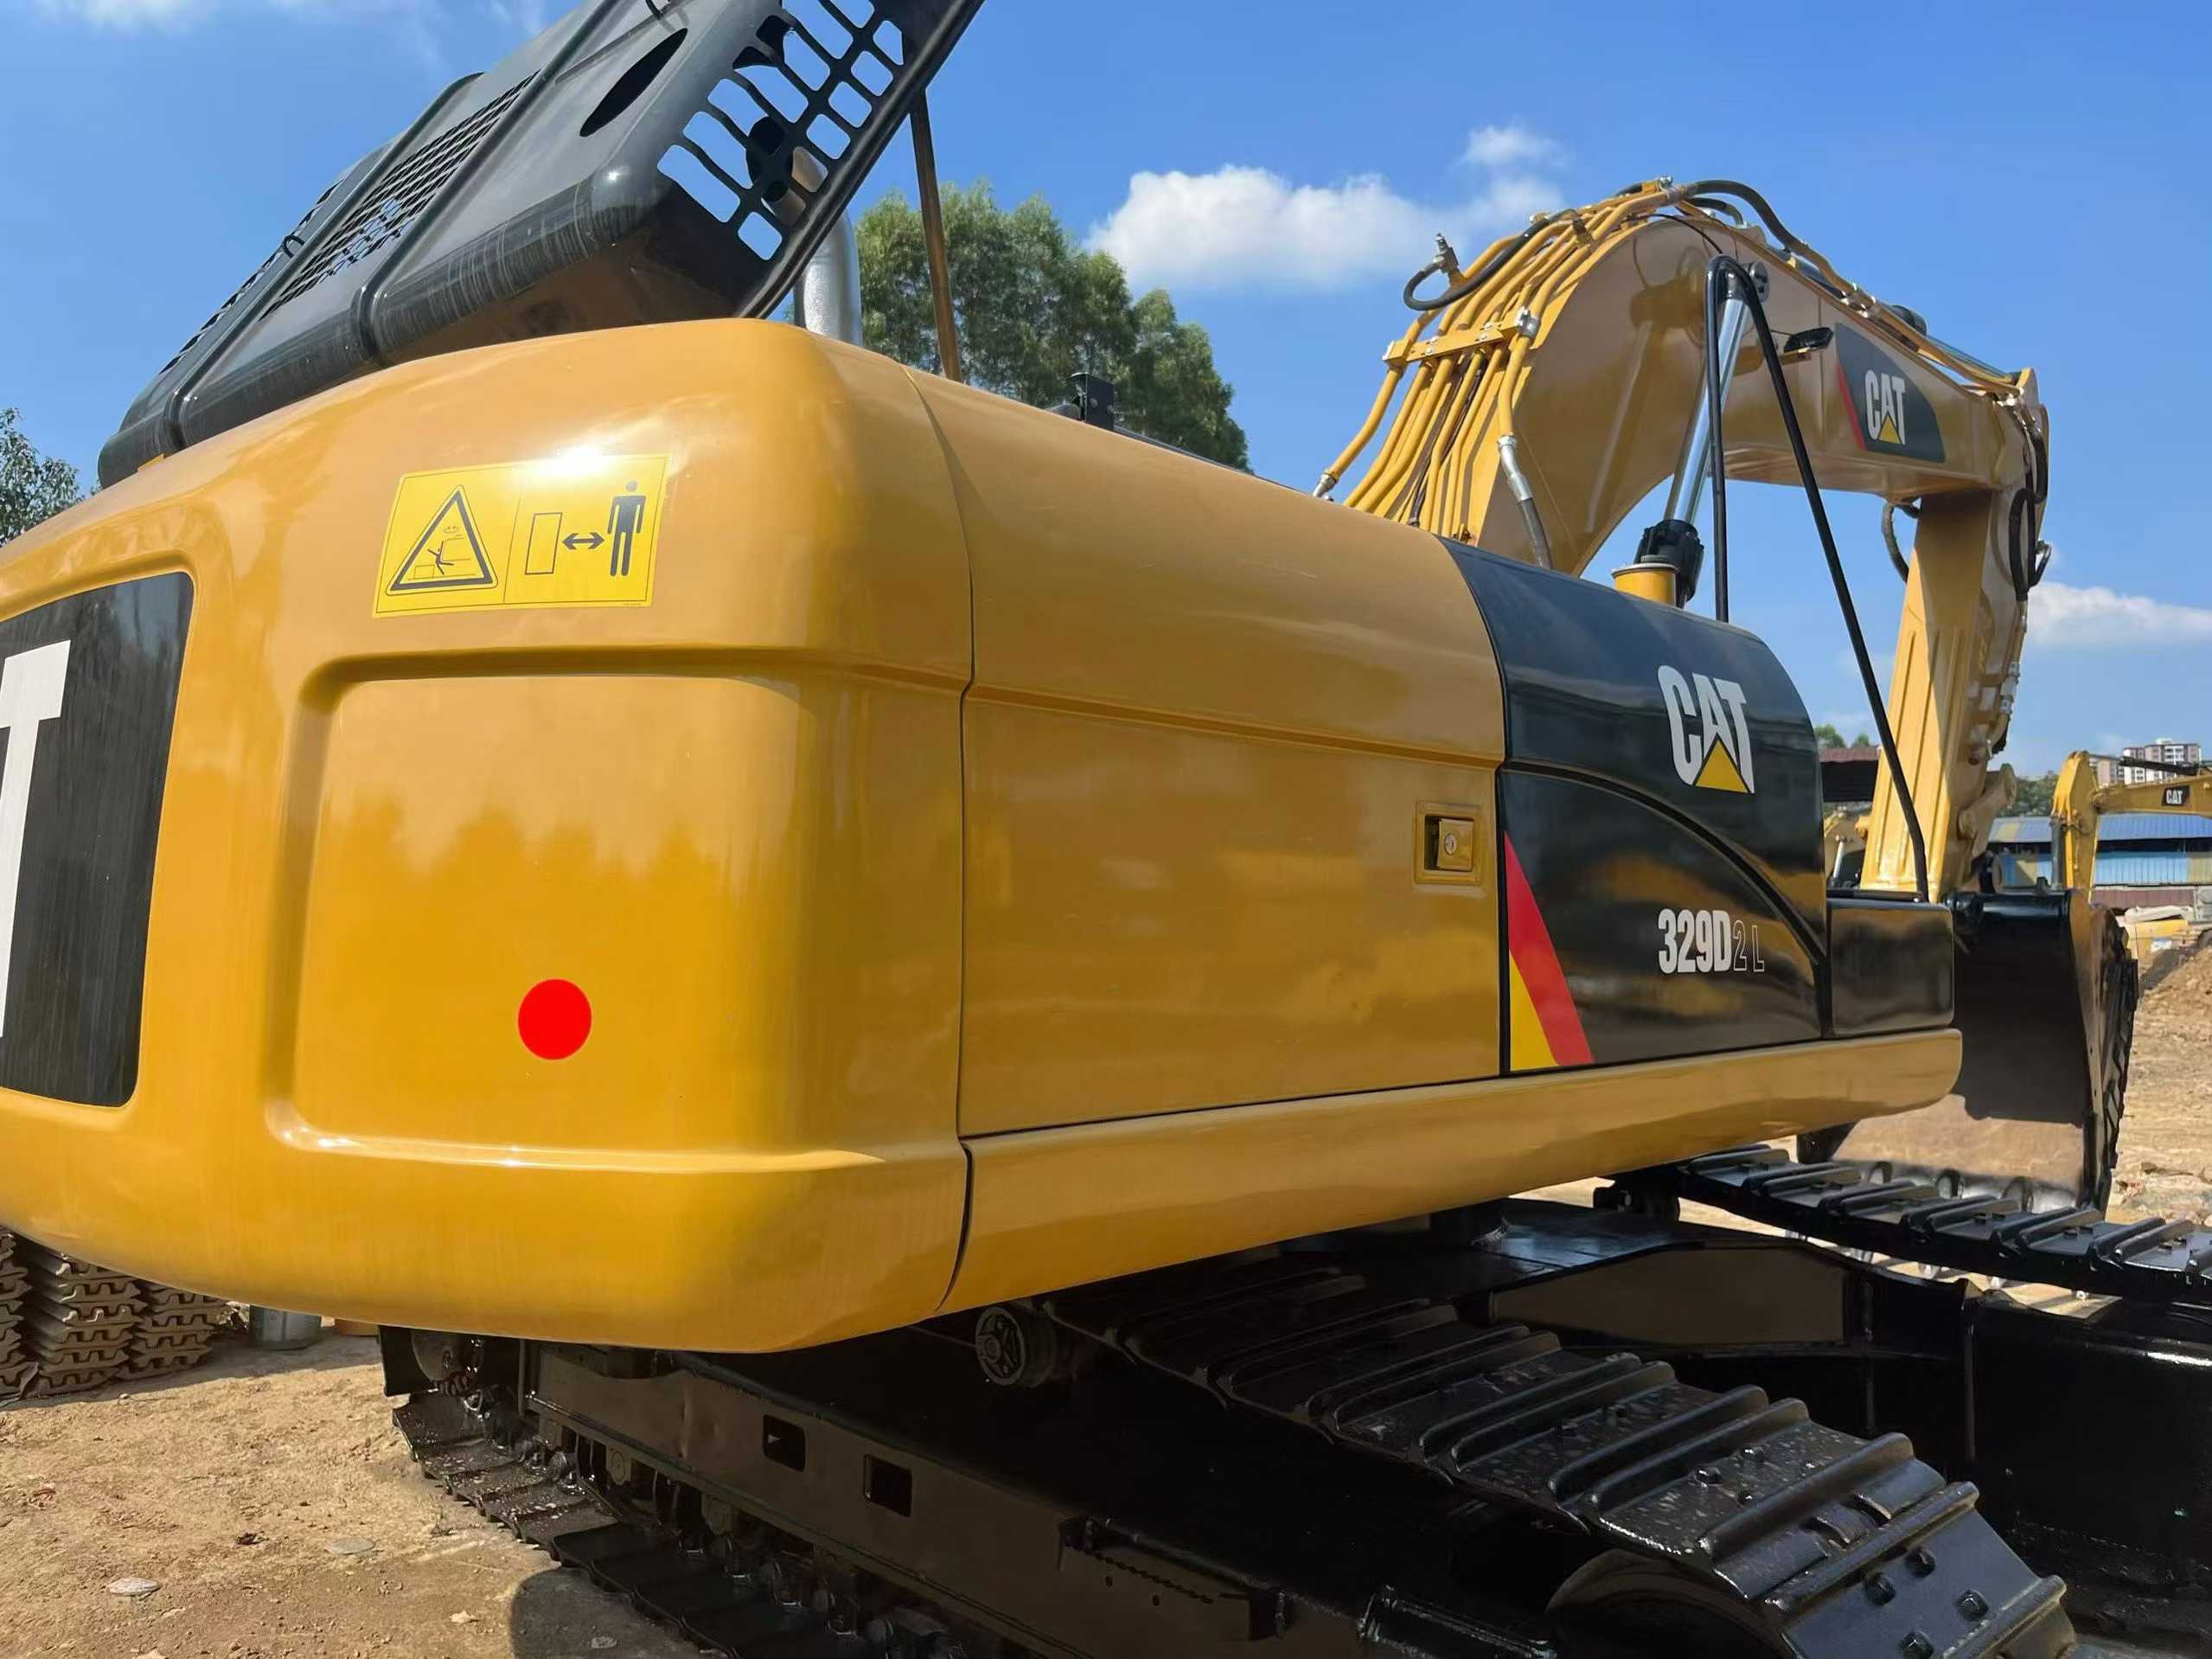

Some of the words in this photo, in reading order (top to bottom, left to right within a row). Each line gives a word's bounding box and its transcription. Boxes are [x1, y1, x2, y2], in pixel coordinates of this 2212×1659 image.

[1864, 369, 1906, 445] CAT
[1658, 665, 1755, 794] CAT
[2165, 789, 2183, 805] CAT
